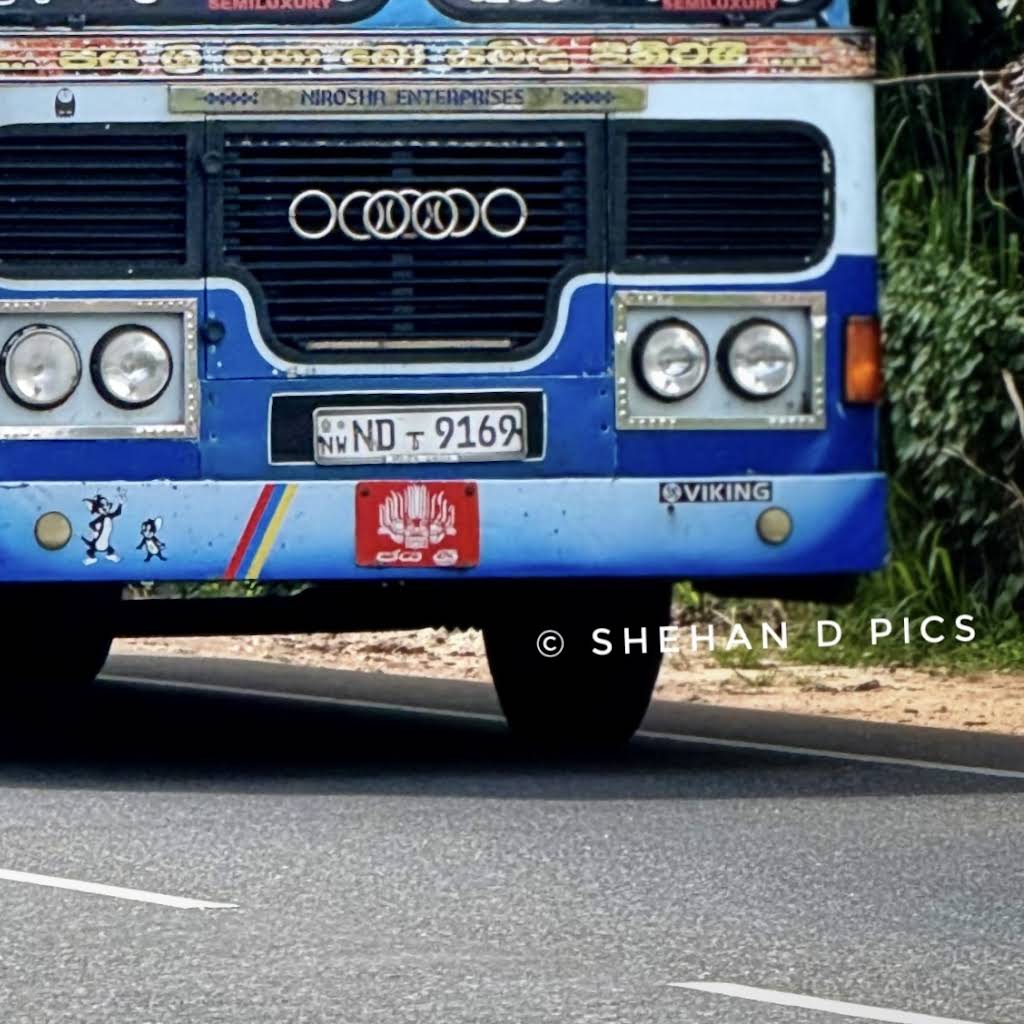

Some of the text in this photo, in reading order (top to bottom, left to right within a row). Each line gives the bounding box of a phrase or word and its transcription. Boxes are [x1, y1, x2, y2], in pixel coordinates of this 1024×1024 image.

[300, 88, 525, 107] NIROSHA ENTERPRISES
[352, 418, 396, 453] ND
[434, 413, 520, 450] 9169
[683, 482, 771, 502] VIKING
